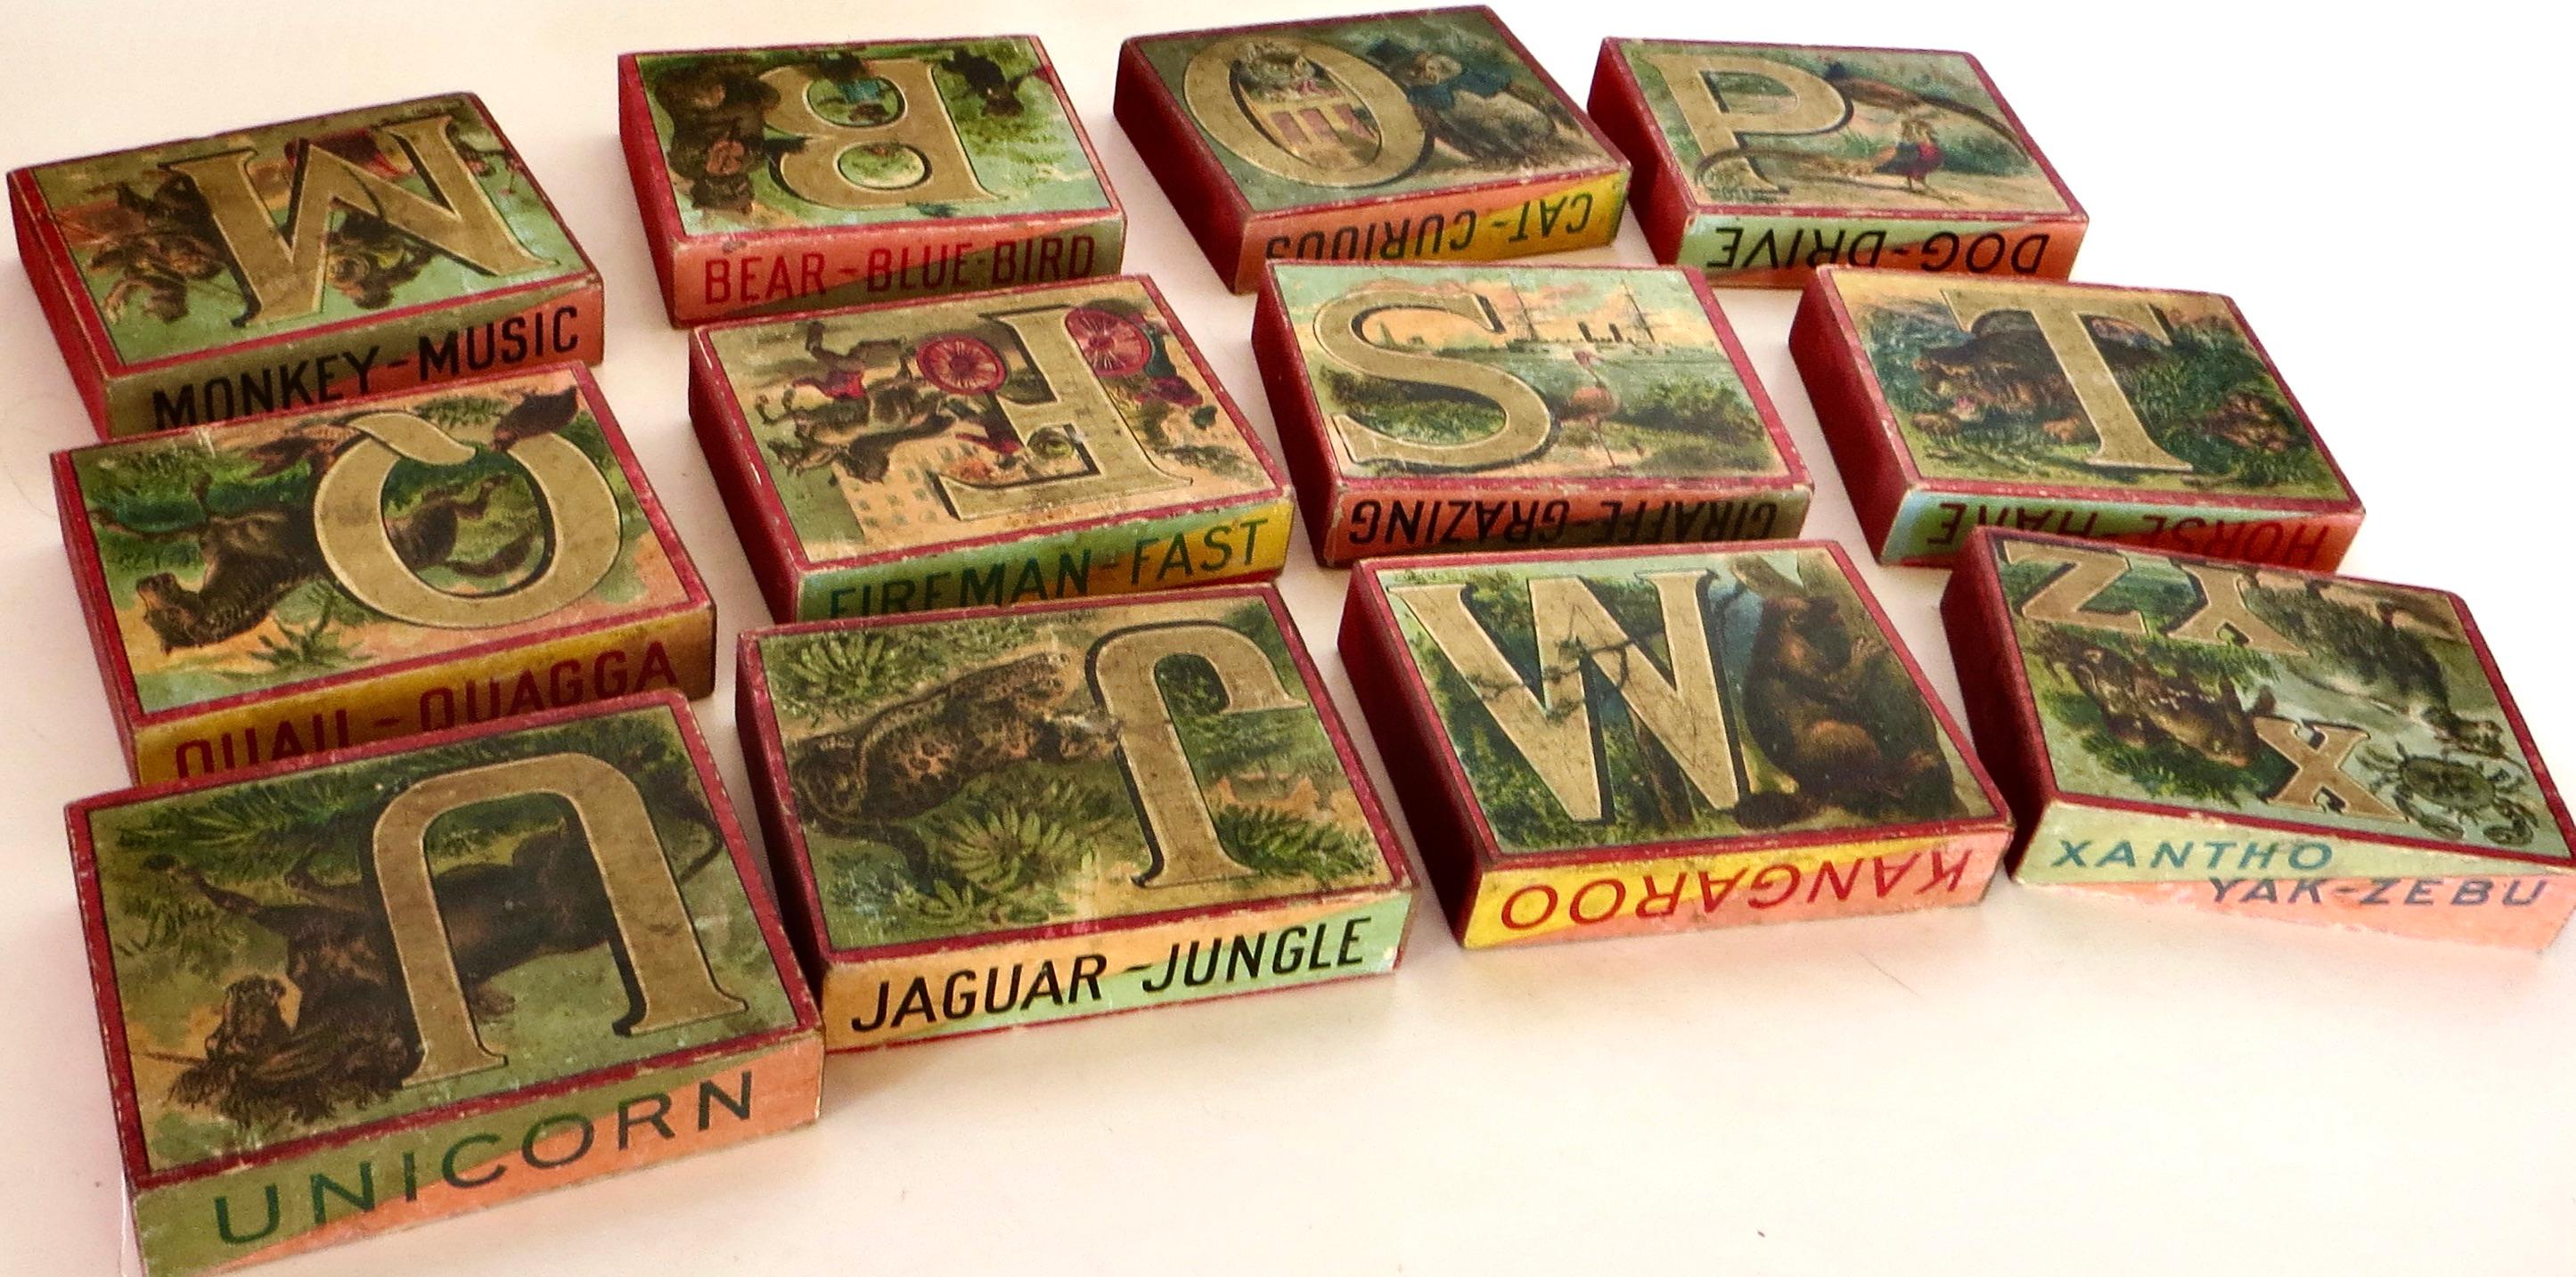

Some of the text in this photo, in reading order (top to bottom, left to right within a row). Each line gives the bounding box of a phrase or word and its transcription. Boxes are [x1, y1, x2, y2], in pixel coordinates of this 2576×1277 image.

[759, 58, 999, 209] B
[1645, 53, 1852, 192] P
[1709, 226, 2049, 274] DOG-DRIVE
[152, 307, 579, 430] MONKEY-MUSIC
[932, 305, 1194, 520] F
[1313, 289, 1554, 471] S
[1941, 288, 2194, 472] T
[314, 410, 621, 628] Q
[1084, 619, 1311, 887] J
[1387, 568, 1745, 823] W
[2253, 716, 2408, 822] X
[372, 751, 748, 1086] U
[1501, 848, 1973, 930] KANGAROO
[2051, 839, 2333, 871] XANTHO
[2209, 877, 2547, 907] YAK-ZEBU
[851, 917, 1371, 1033] JAGUAR-JUNGLE
[215, 1070, 753, 1245] UNICORN
